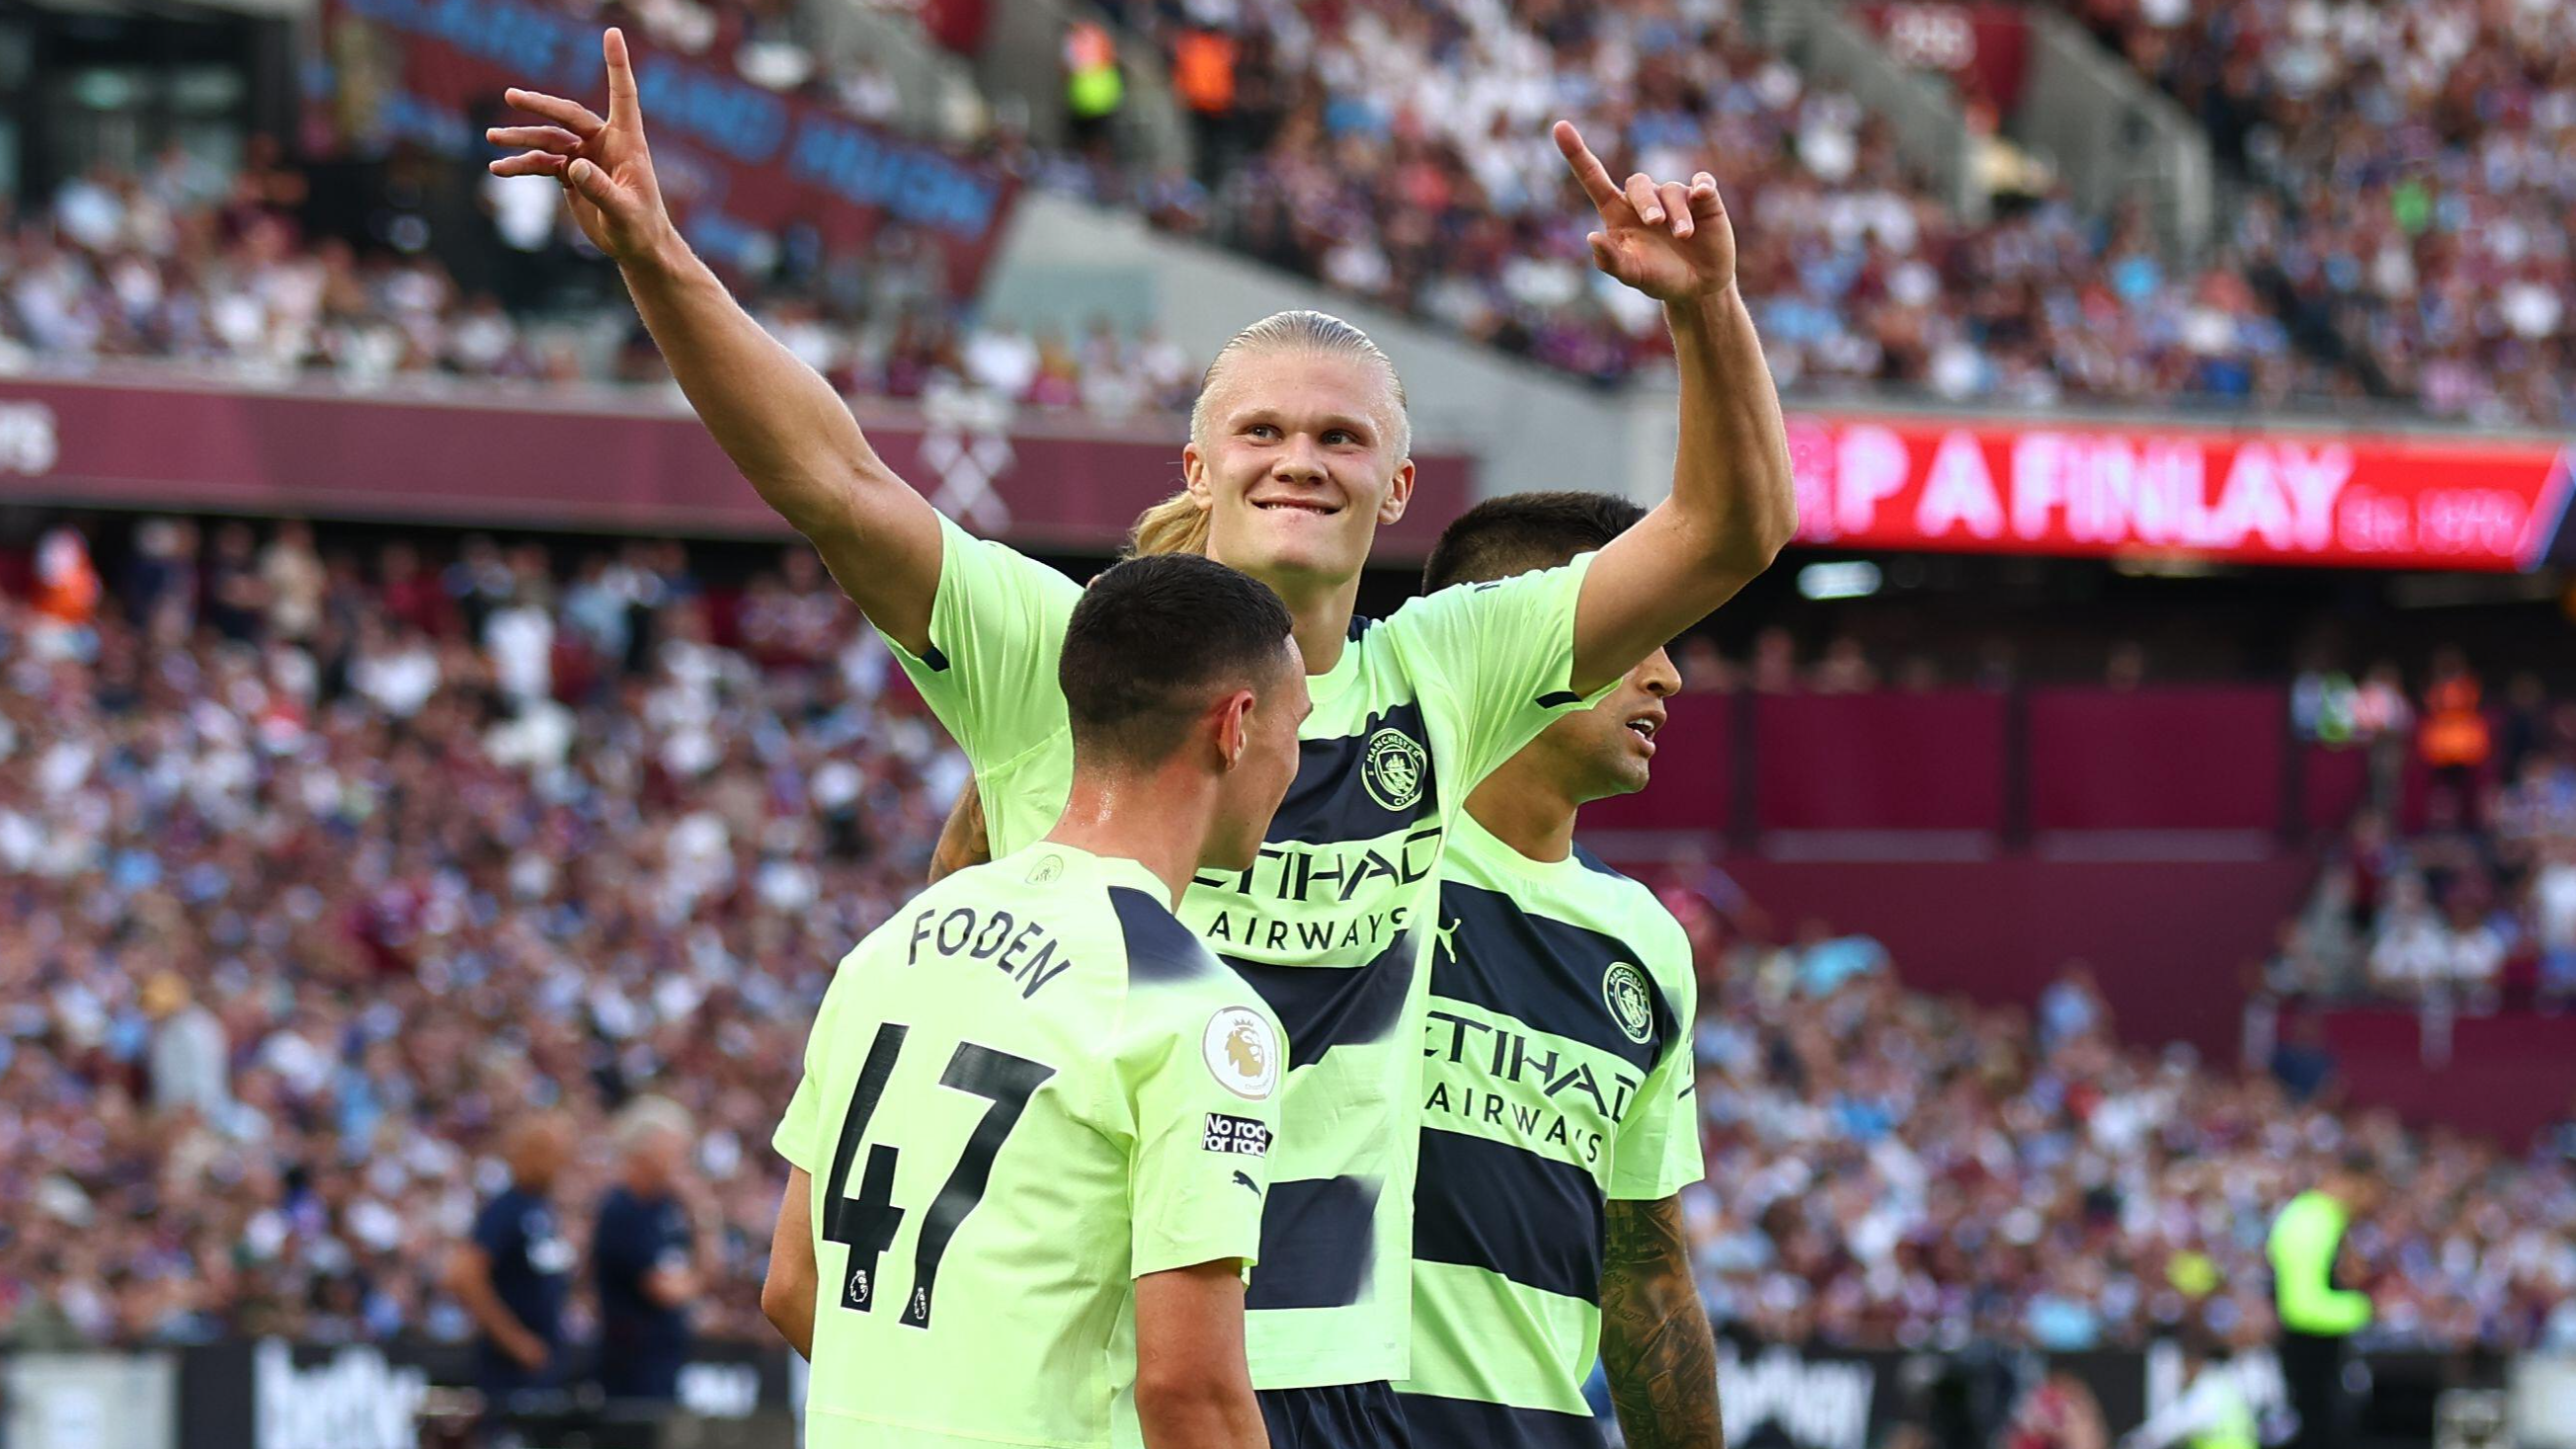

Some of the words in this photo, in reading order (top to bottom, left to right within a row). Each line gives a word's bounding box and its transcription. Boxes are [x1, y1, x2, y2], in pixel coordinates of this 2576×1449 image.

[1836, 425, 1910, 538] P
[1914, 428, 2004, 540] A
[2013, 428, 2355, 552] FINLAY
[1367, 735, 1420, 763] MANCHESTER
[1394, 791, 1415, 805] CITY
[908, 907, 1072, 1001] FODEN
[1423, 1010, 1638, 1124] TIHAD
[1202, 1130, 1231, 1152] for
[1205, 1113, 1233, 1135] No
[1424, 1082, 1602, 1164] AIRWAS
[822, 1021, 1058, 1330] 47
